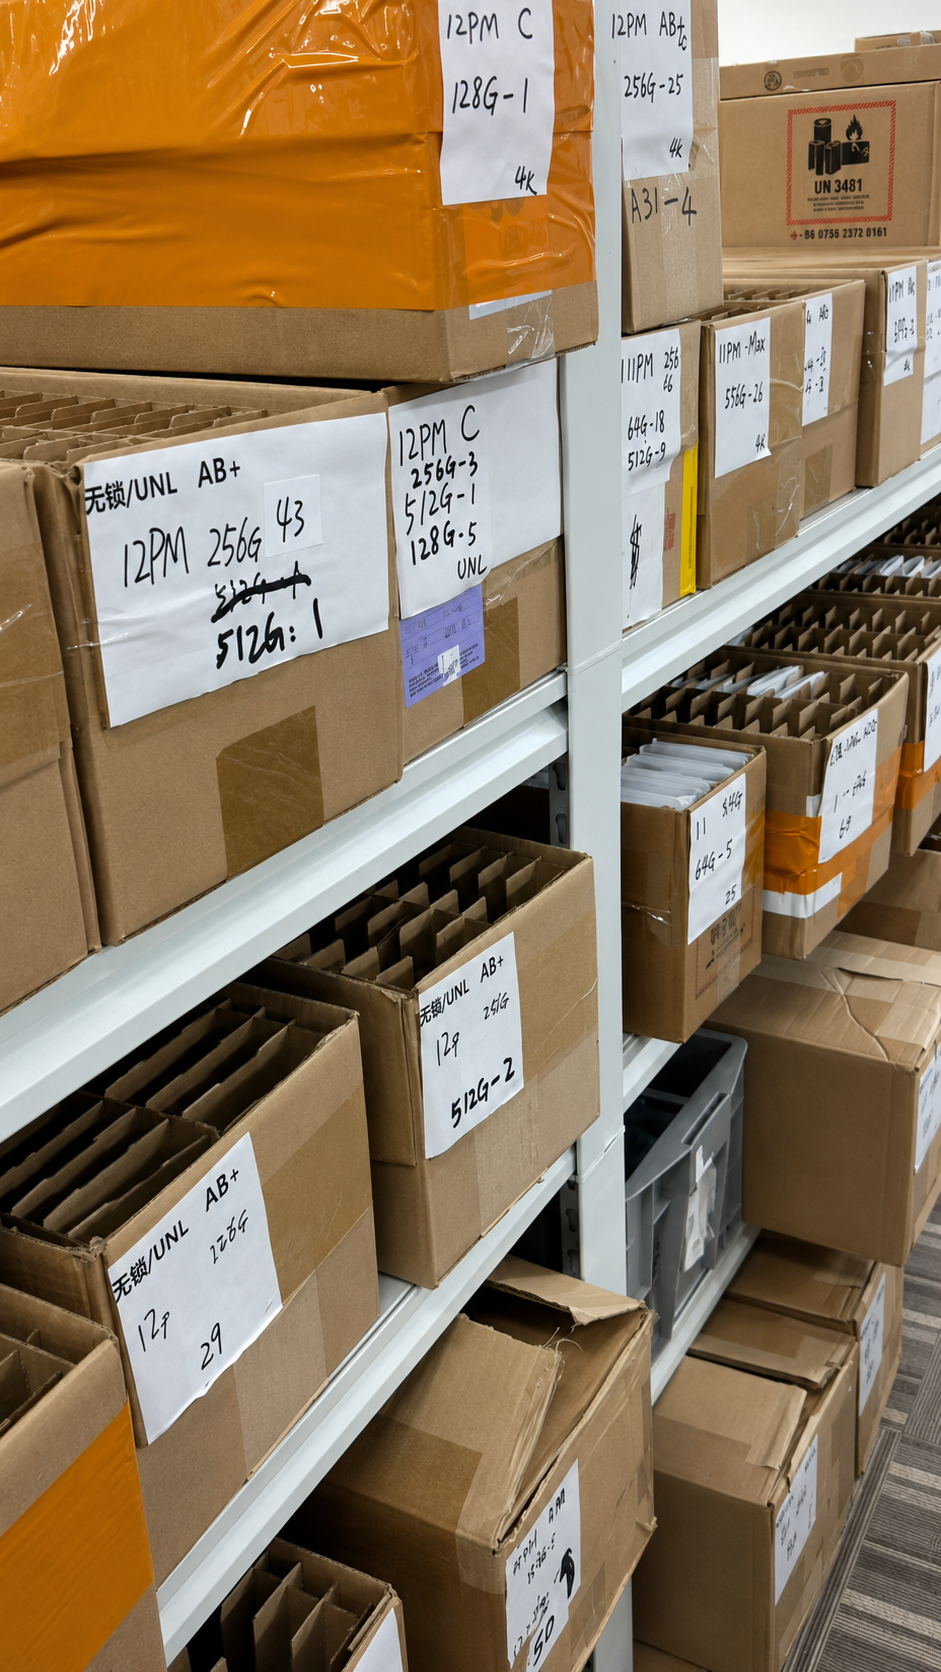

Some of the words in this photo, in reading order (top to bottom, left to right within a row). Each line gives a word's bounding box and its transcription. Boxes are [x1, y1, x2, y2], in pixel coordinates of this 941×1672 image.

[447, 11, 499, 44] 12PM
[518, 8, 533, 39] C
[611, 13, 648, 39] 12PM
[814, 179, 831, 194] UN
[834, 178, 862, 193] 3481
[866, 226, 887, 238] 0161
[400, 418, 448, 466] 12PM
[461, 404, 480, 441] C
[198, 457, 241, 488] AB+
[276, 496, 305, 543] 43
[124, 526, 189, 588] 12PM
[207, 516, 262, 567] 256G
[457, 554, 487, 580] UNL
[480, 955, 504, 983] AB+
[205, 1168, 240, 1212] AB+
[200, 1322, 222, 1370] 29
